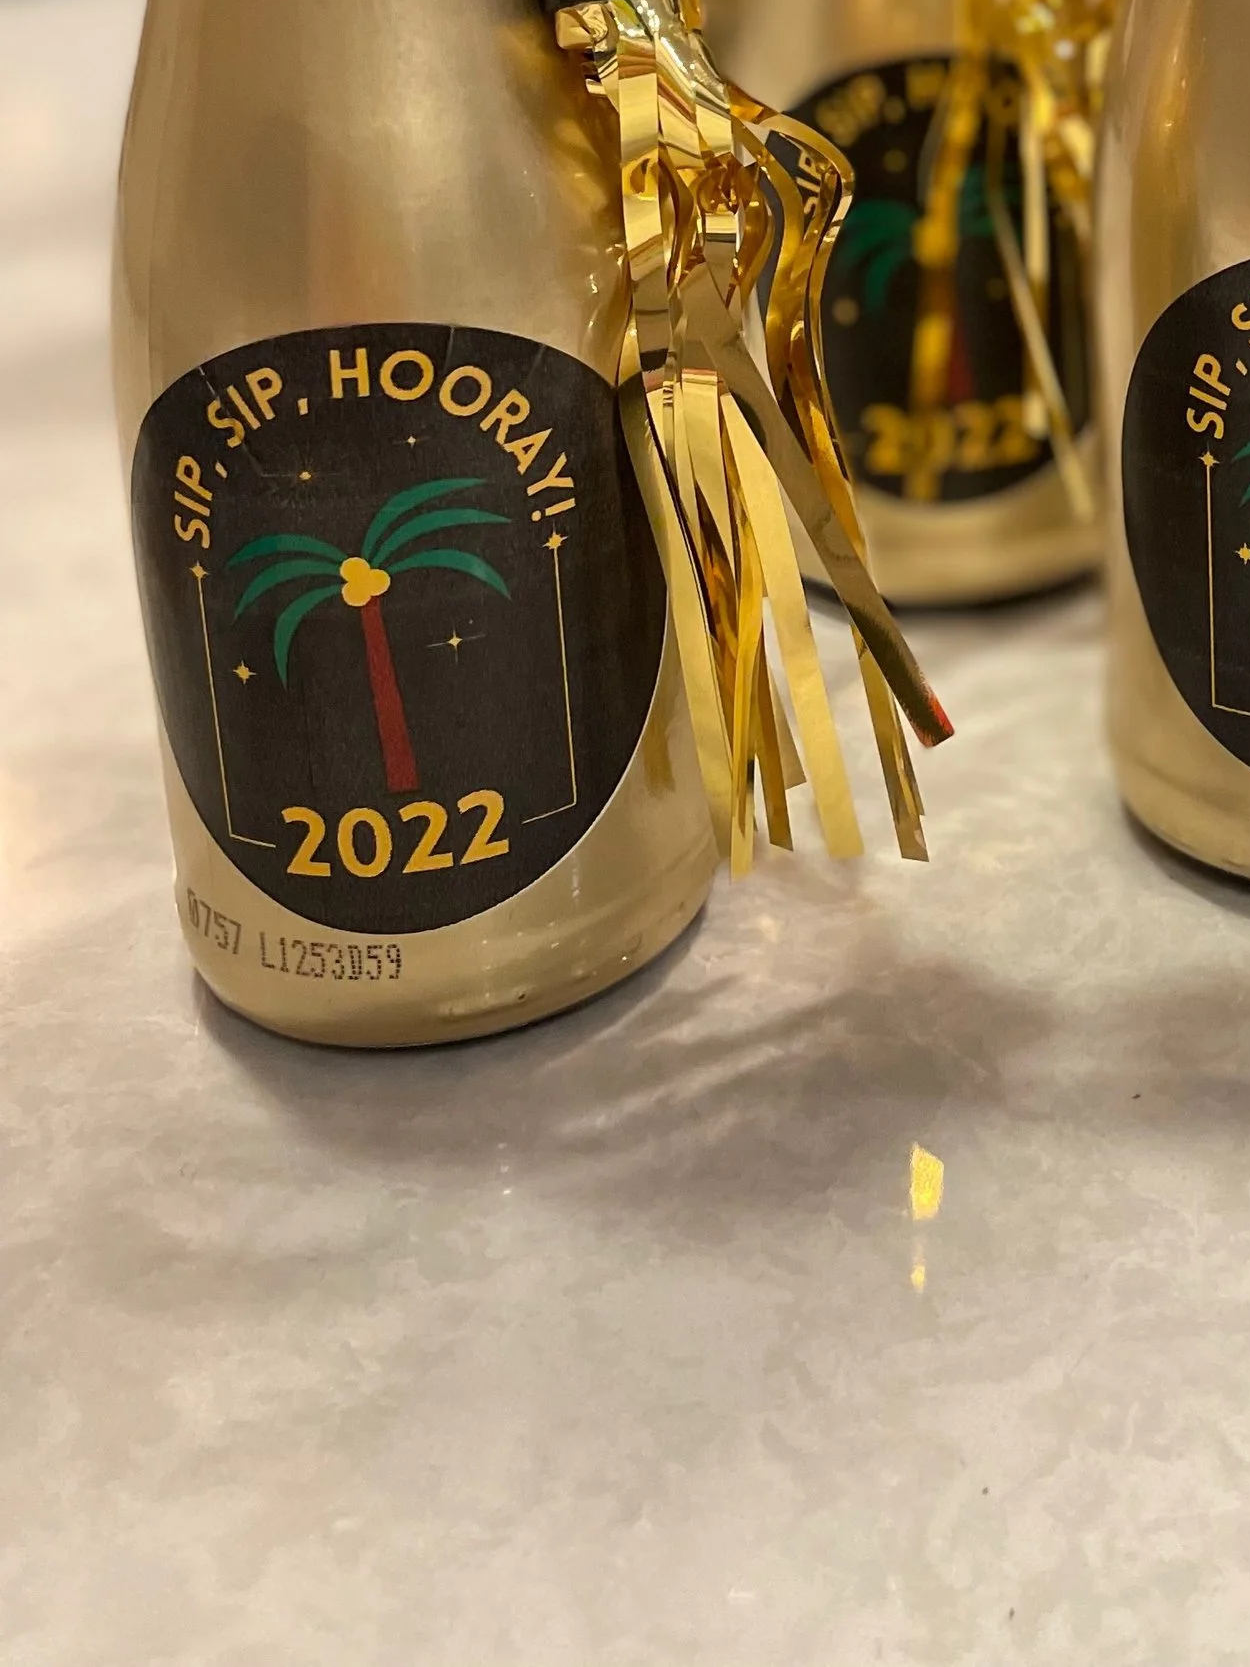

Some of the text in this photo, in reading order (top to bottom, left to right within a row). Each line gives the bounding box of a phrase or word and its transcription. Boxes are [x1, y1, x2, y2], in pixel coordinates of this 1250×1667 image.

[1186, 353, 1248, 440] SIP,
[174, 347, 576, 549] SIP, SIP, HOORAY!
[280, 788, 510, 878] 2022
